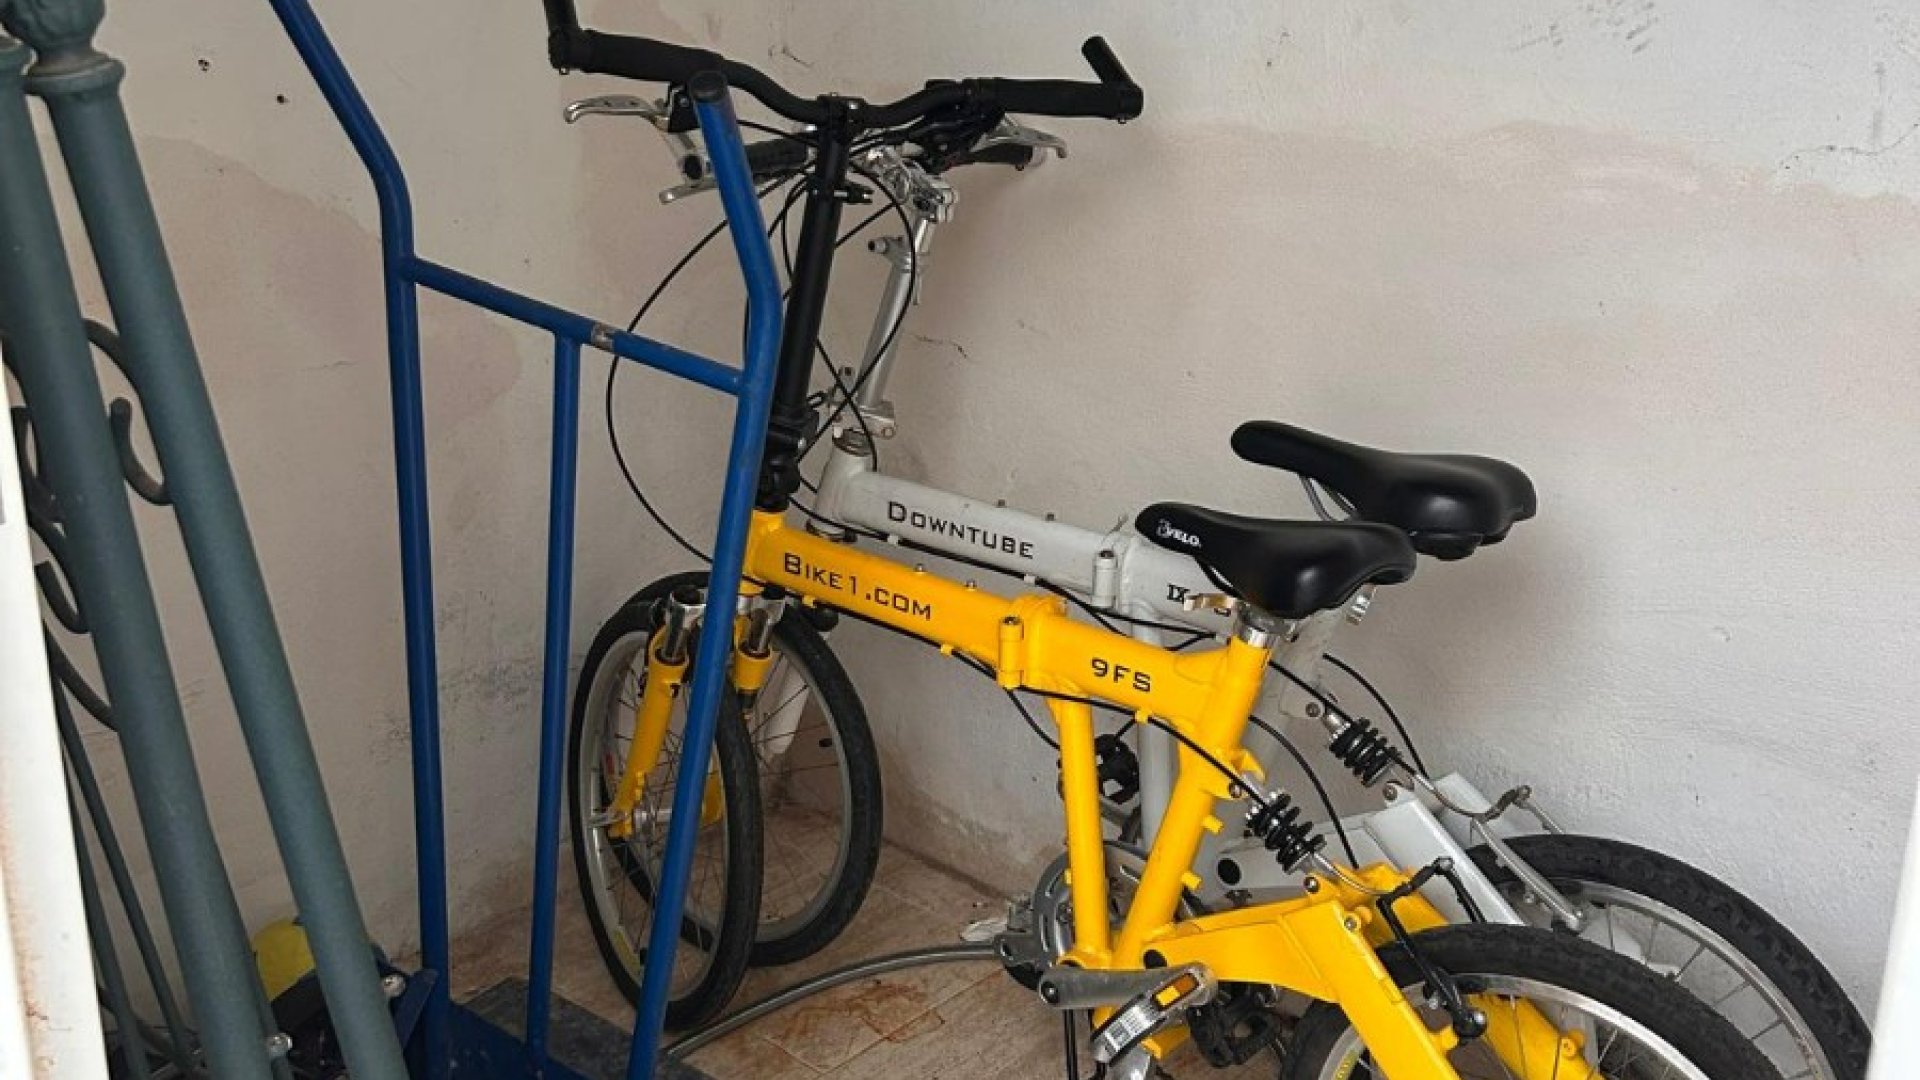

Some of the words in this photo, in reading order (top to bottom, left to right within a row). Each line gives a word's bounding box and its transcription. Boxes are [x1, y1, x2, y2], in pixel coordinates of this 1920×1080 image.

[888, 501, 1034, 560] DOWNTUBE
[784, 552, 932, 622] BIKE1.COM
[1091, 657, 1152, 692] 9FS
